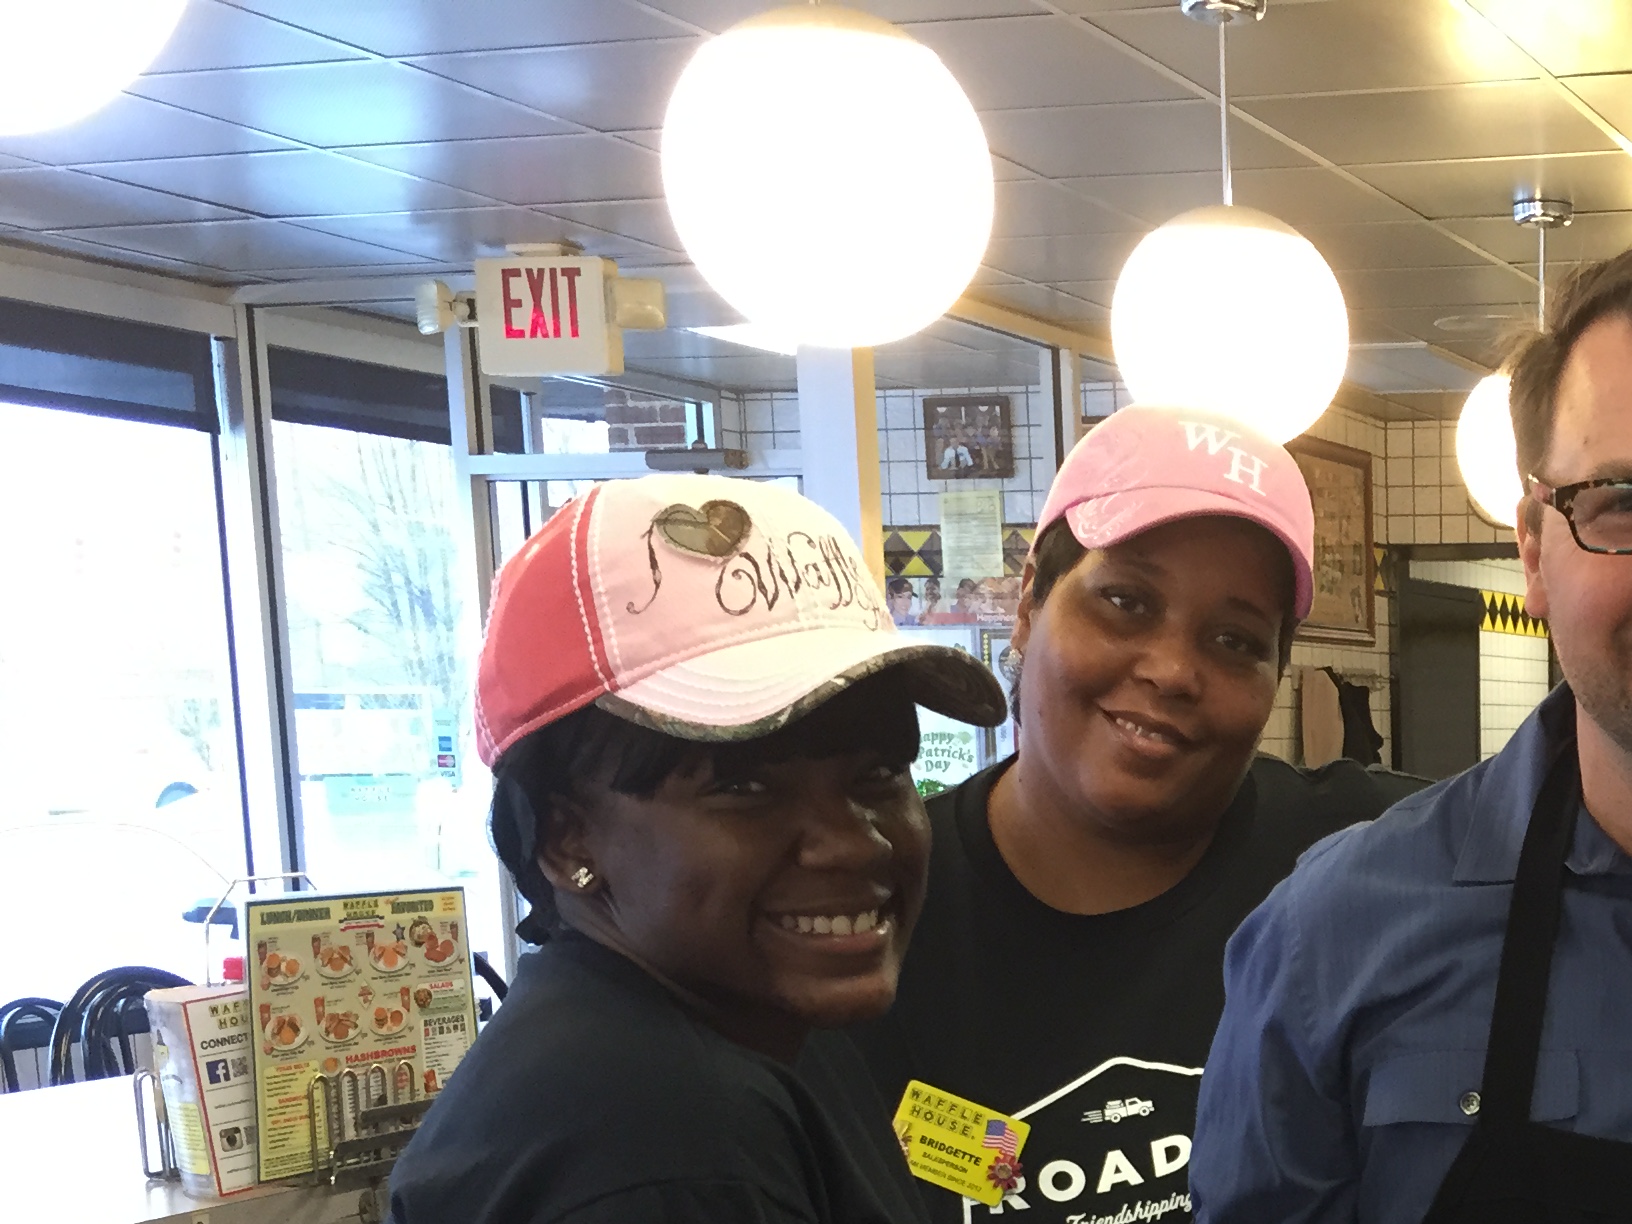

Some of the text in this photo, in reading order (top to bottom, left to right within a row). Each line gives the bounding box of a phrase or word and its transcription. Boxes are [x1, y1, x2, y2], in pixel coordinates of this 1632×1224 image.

[501, 267, 581, 339] EXIT
[715, 531, 858, 616] Waffle
[922, 731, 955, 745] appy
[925, 759, 952, 773] Day
[423, 1015, 465, 1027] BEVERAGES
[200, 1032, 249, 1050] CONNECT
[345, 1045, 417, 1063] HASHBROWNS
[909, 1088, 984, 1126] WAFFLE
[919, 1135, 982, 1167] BRIDGETTE
